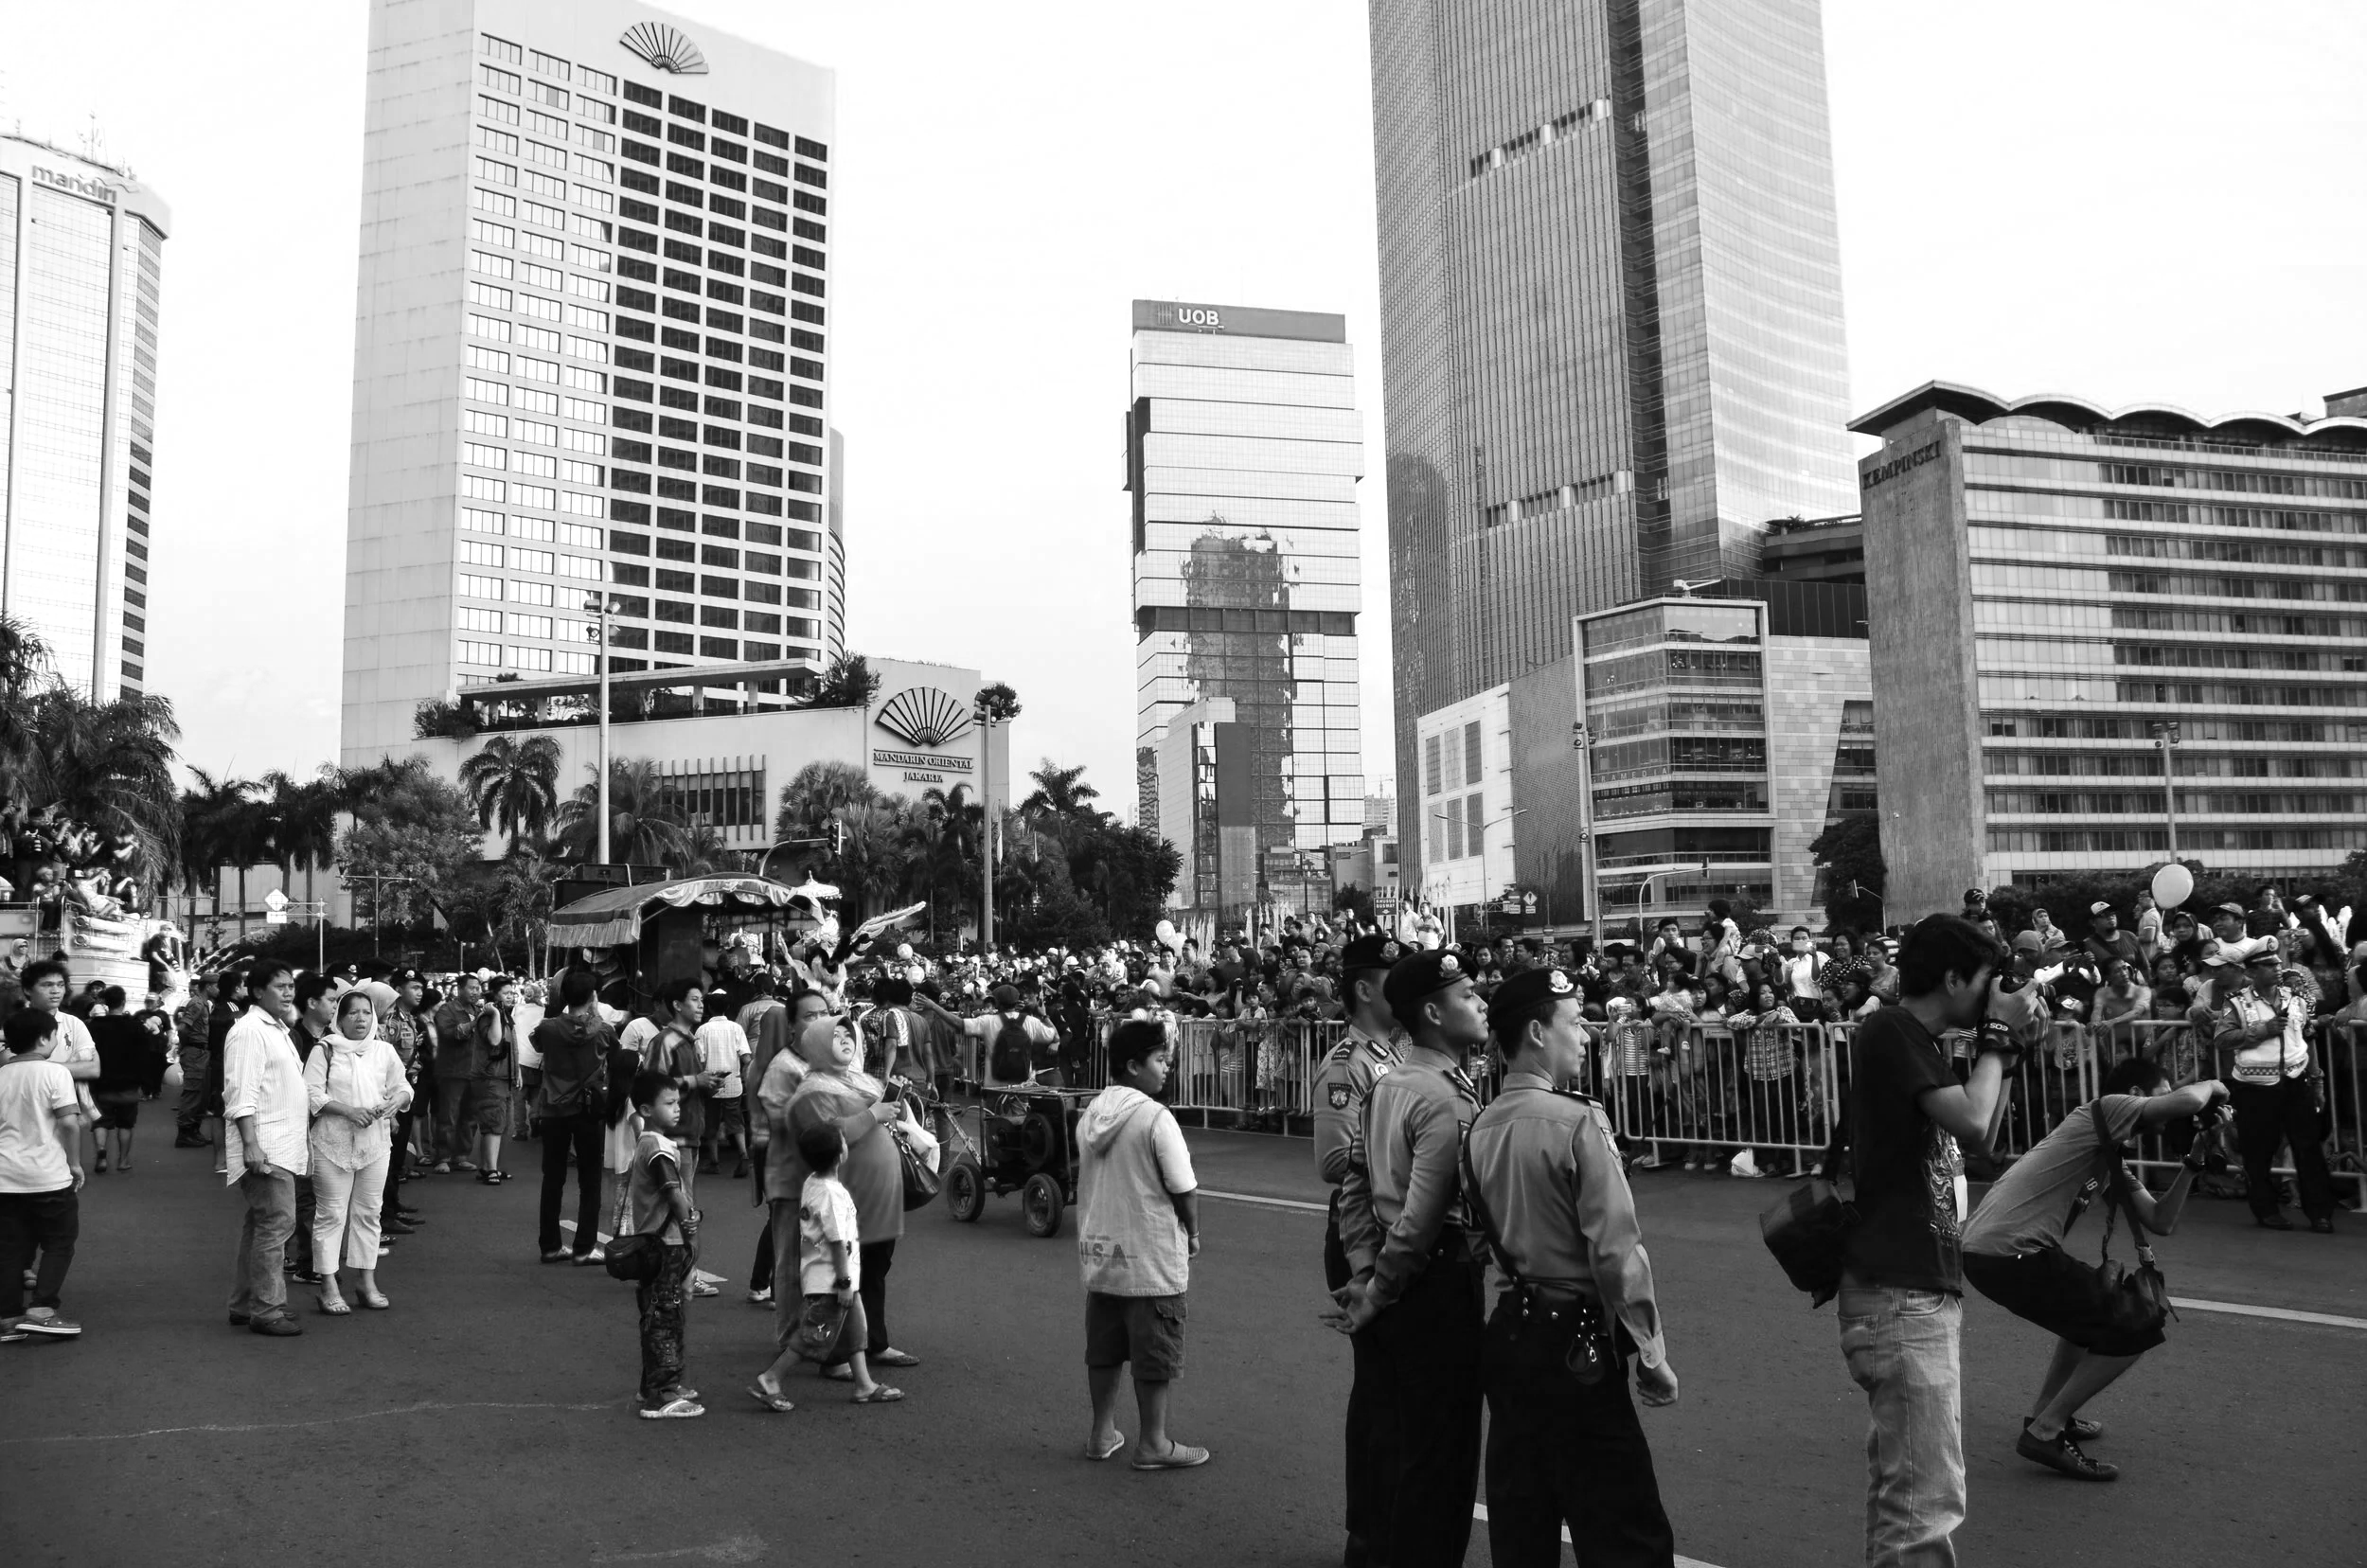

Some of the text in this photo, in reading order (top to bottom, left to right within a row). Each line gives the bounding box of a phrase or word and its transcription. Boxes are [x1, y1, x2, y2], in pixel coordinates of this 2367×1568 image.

[32, 165, 116, 204] mandiri
[1178, 308, 1219, 326] UOB
[1862, 440, 1940, 490] KEMPINSKI
[873, 752, 973, 770] MANDARIN ORIENTAL
[903, 772, 943, 783] JAKARTA
[1988, 1022, 2009, 1032] EOS
